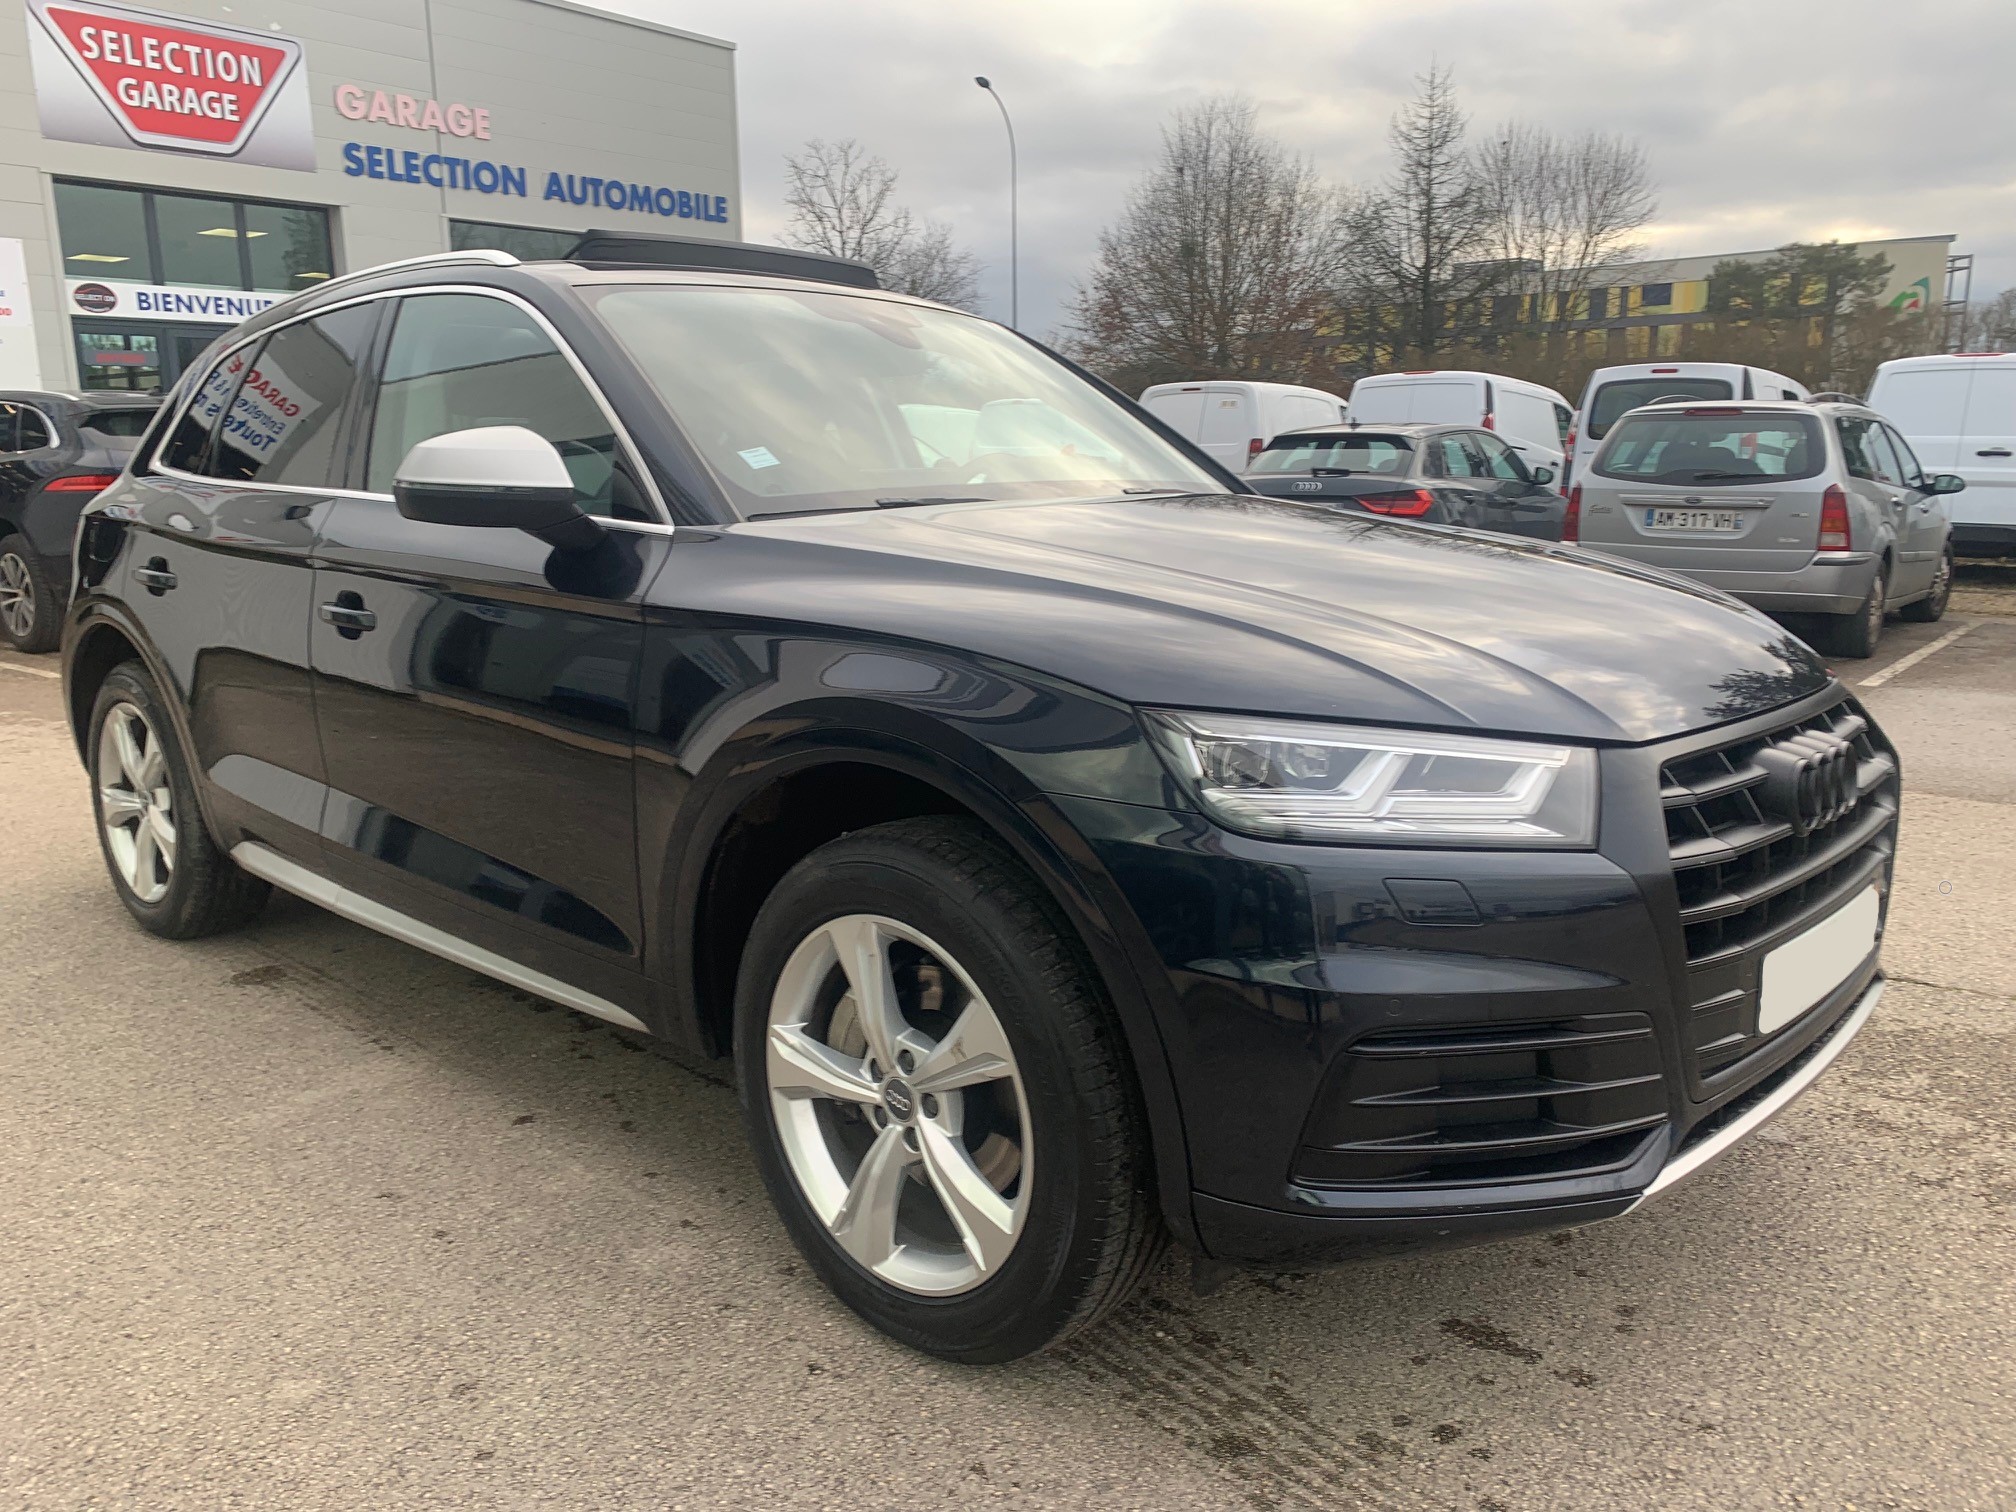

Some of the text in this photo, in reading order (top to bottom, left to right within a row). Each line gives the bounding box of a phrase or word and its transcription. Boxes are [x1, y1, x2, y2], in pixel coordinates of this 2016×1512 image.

[79, 25, 262, 87] SELECTION
[116, 77, 241, 122] GARAGE
[334, 84, 491, 140] GARAGE
[343, 142, 728, 223] SELECTION AUTOMOBILE
